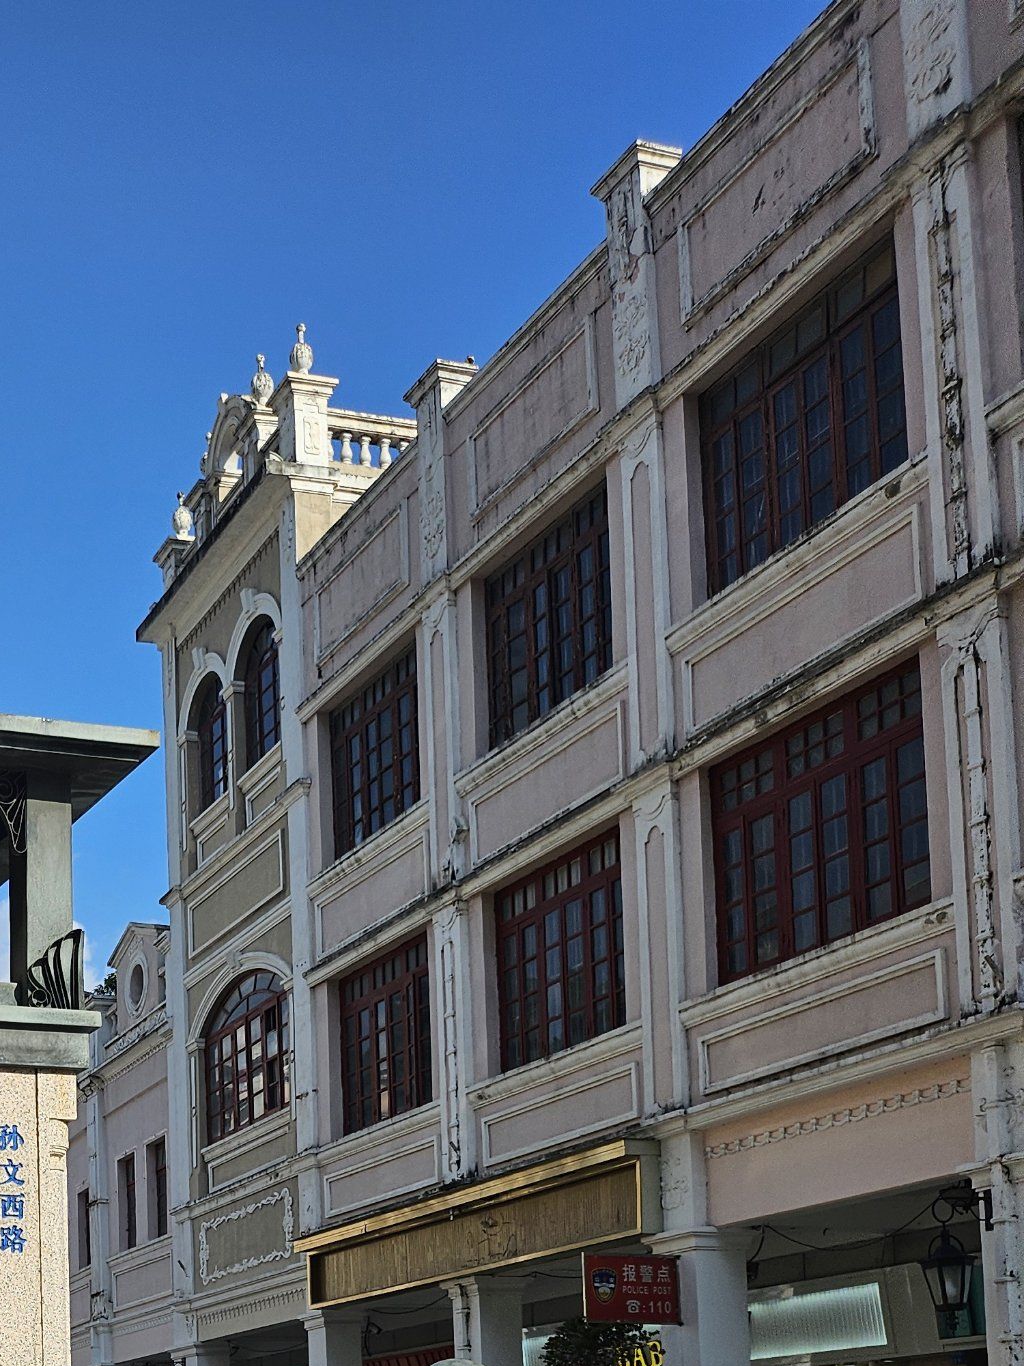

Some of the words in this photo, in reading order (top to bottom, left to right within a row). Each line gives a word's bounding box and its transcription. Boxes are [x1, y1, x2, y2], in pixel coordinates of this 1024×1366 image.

[622, 1264, 671, 1283] 报警点
[622, 1285, 649, 1295] POLICE
[653, 1286, 672, 1295] POST
